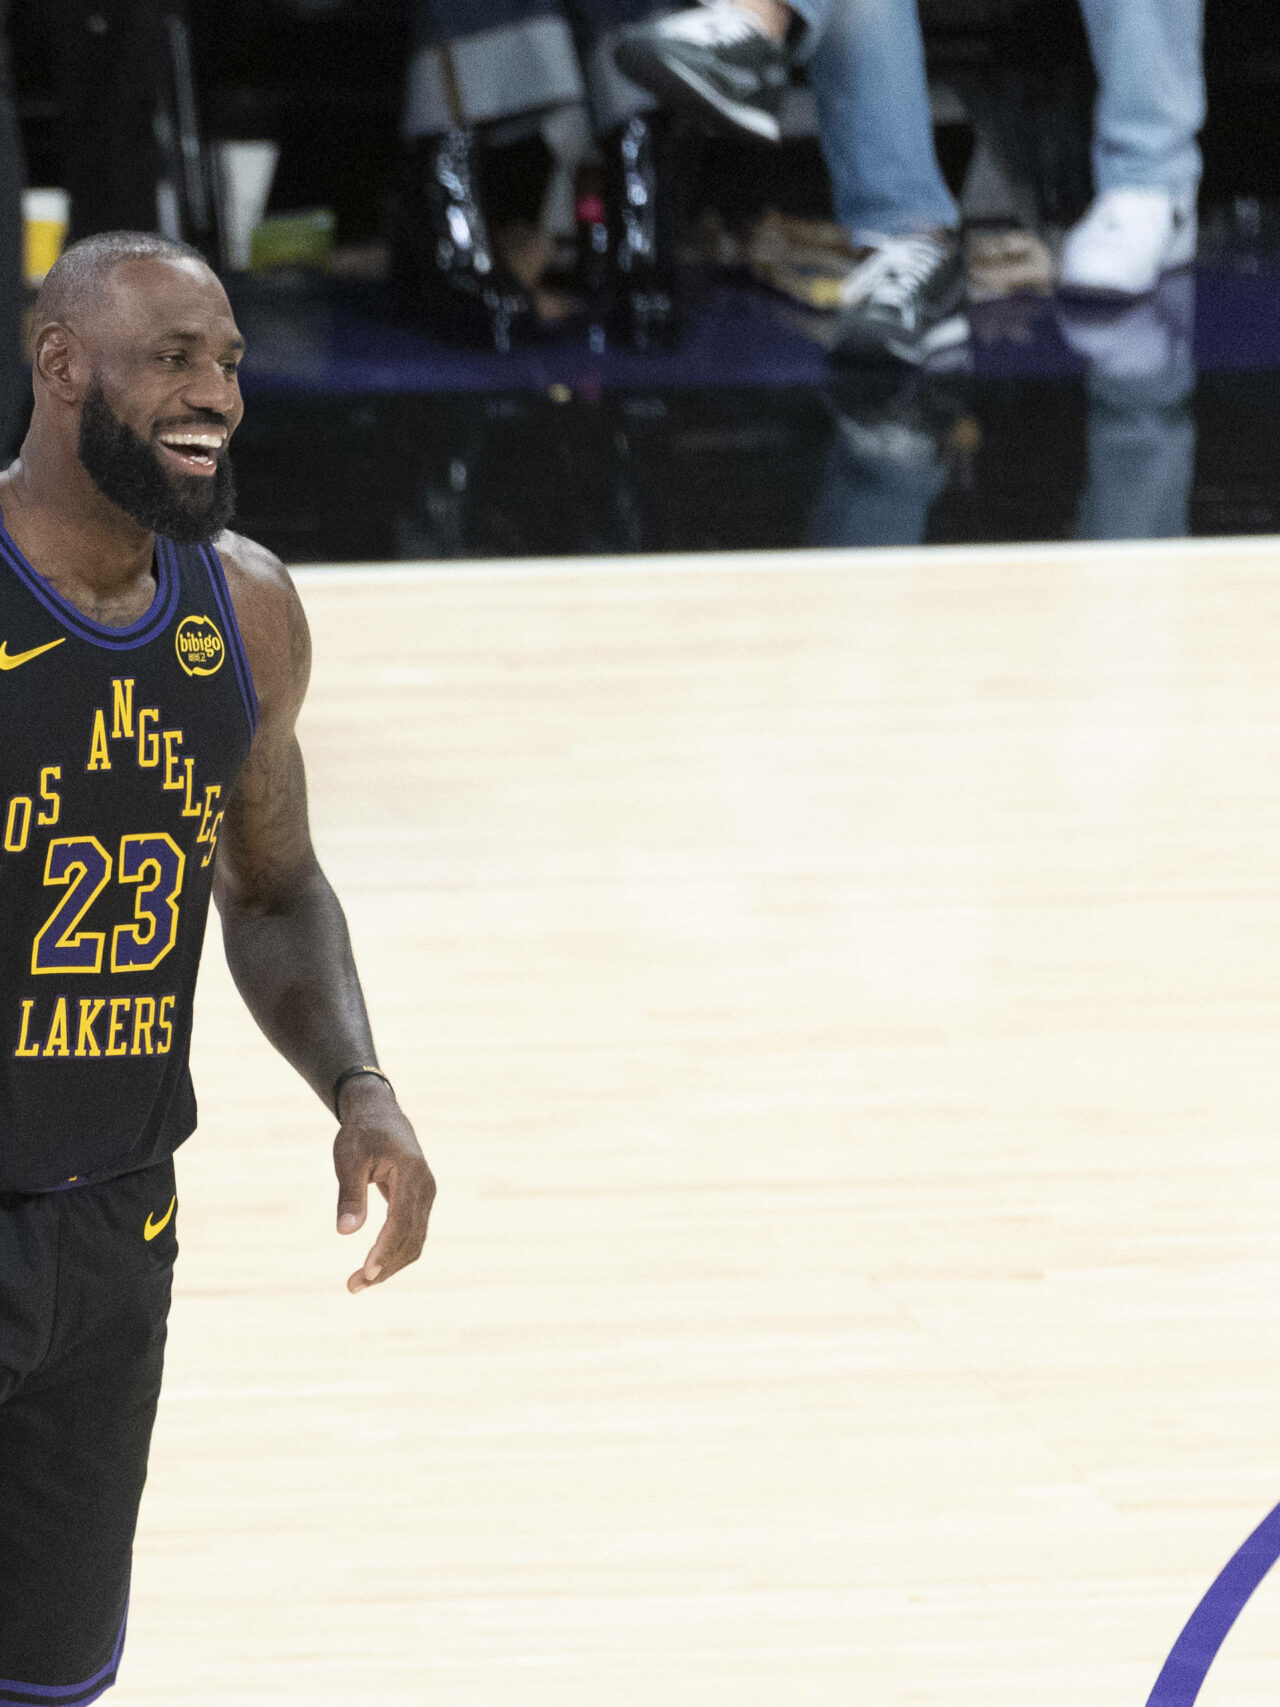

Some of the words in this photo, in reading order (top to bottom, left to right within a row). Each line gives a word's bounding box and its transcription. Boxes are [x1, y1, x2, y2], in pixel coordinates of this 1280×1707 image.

[179, 631, 221, 657] bibigo
[87, 678, 224, 868] ANGELES
[31, 832, 186, 975] 23
[14, 995, 176, 1057] LAKERS
